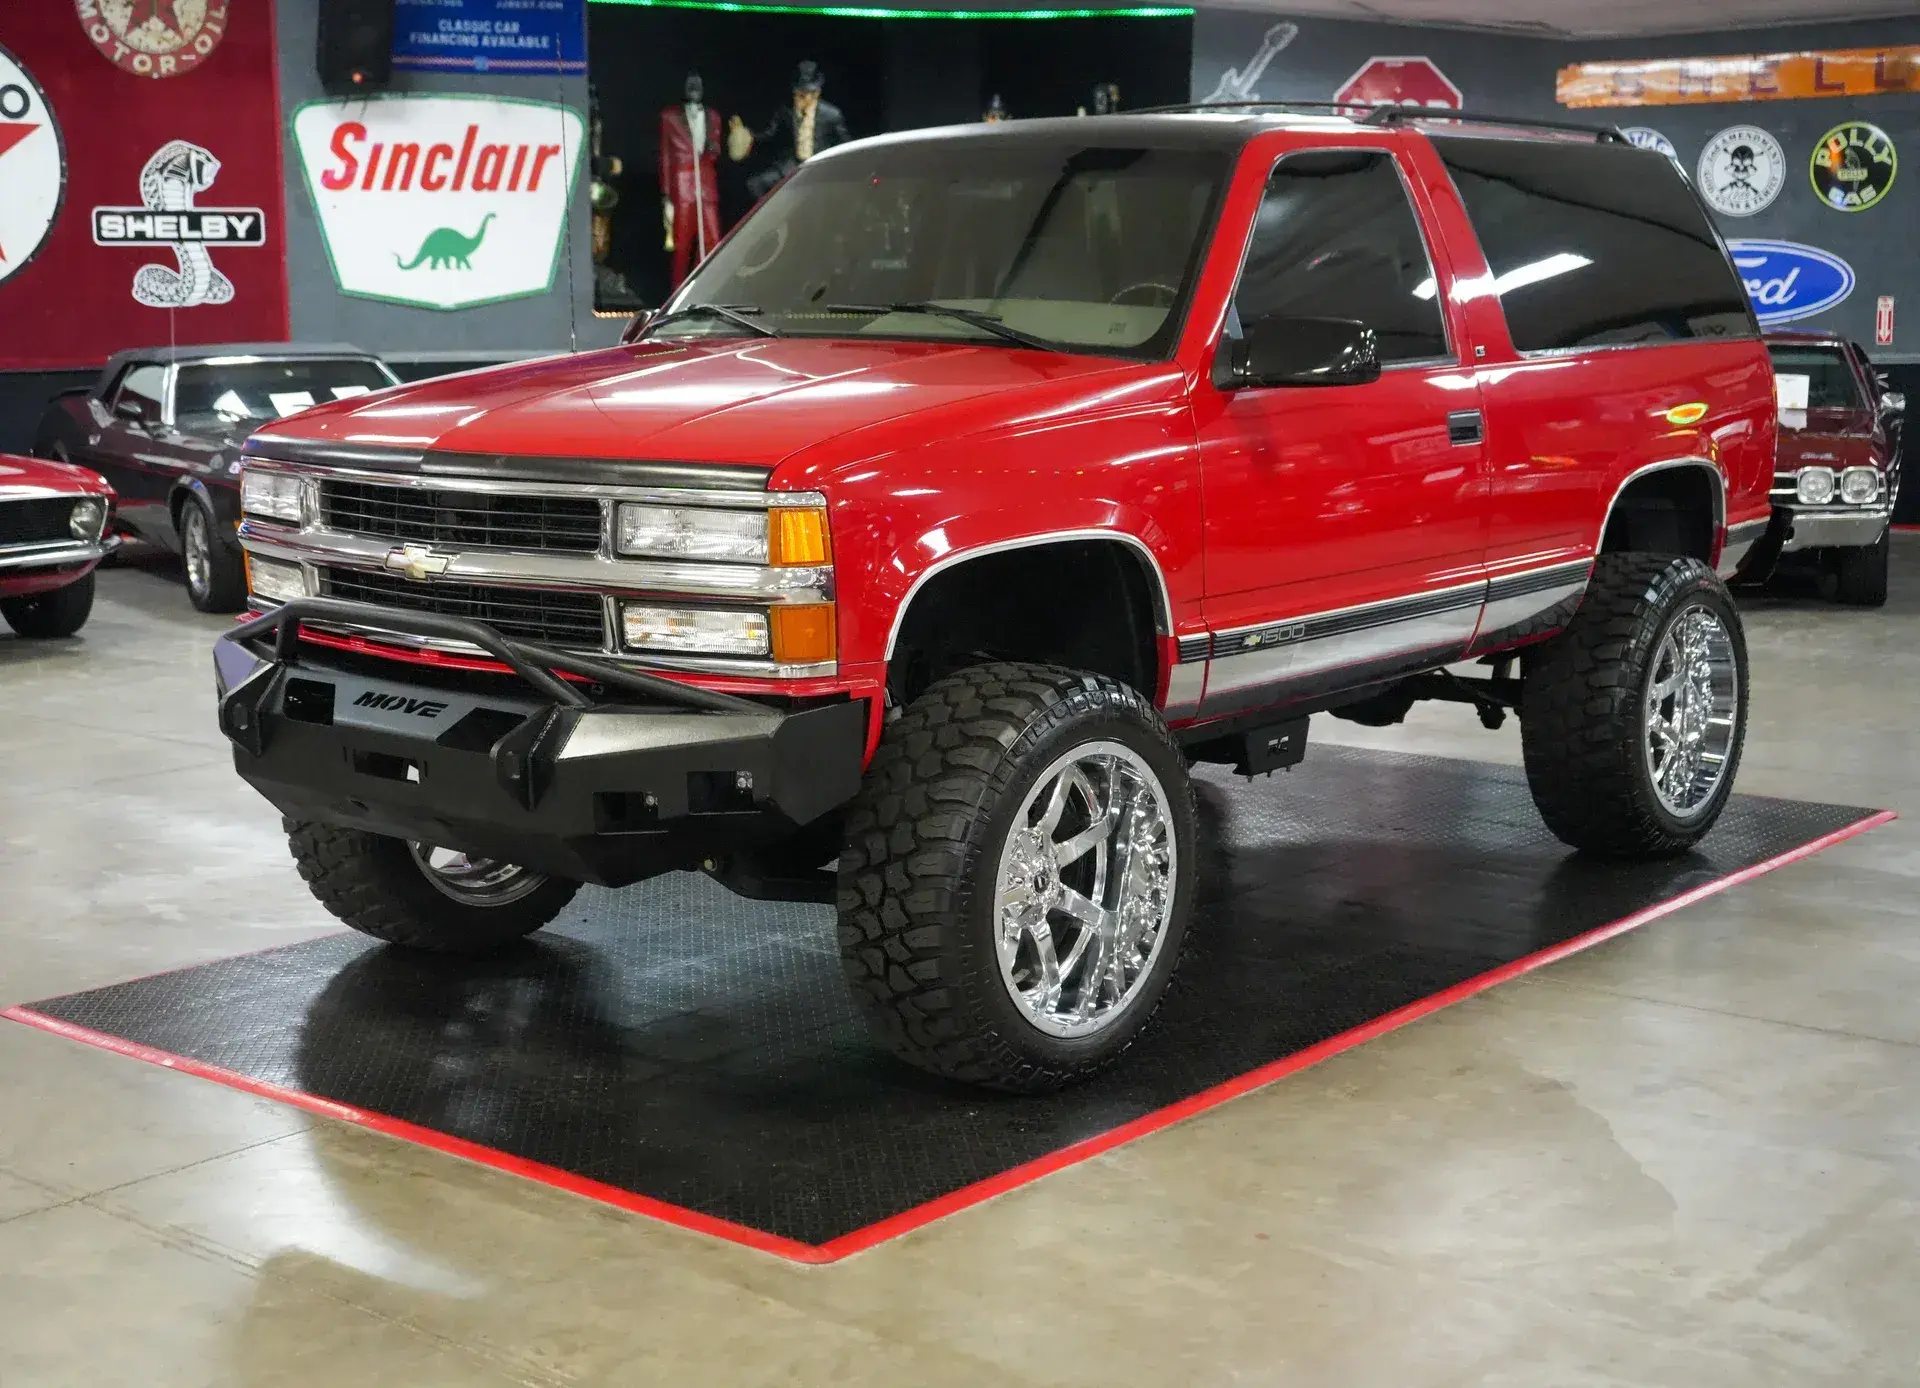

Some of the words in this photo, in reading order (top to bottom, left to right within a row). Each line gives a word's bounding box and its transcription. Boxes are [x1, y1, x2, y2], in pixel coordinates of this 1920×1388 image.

[438, 18, 491, 33] CLASSIC
[494, 21, 521, 34] CAR
[409, 32, 480, 48] FINANCING
[481, 35, 550, 49] AVAILABLE
[1611, 52, 1907, 97] SHELL
[320, 121, 562, 192] Sinclair
[1816, 128, 1893, 167] POLLY
[1828, 184, 1877, 206] GAS
[100, 215, 256, 240] SHELBY
[1261, 623, 1306, 644] 1500
[352, 690, 449, 719] MOVE
